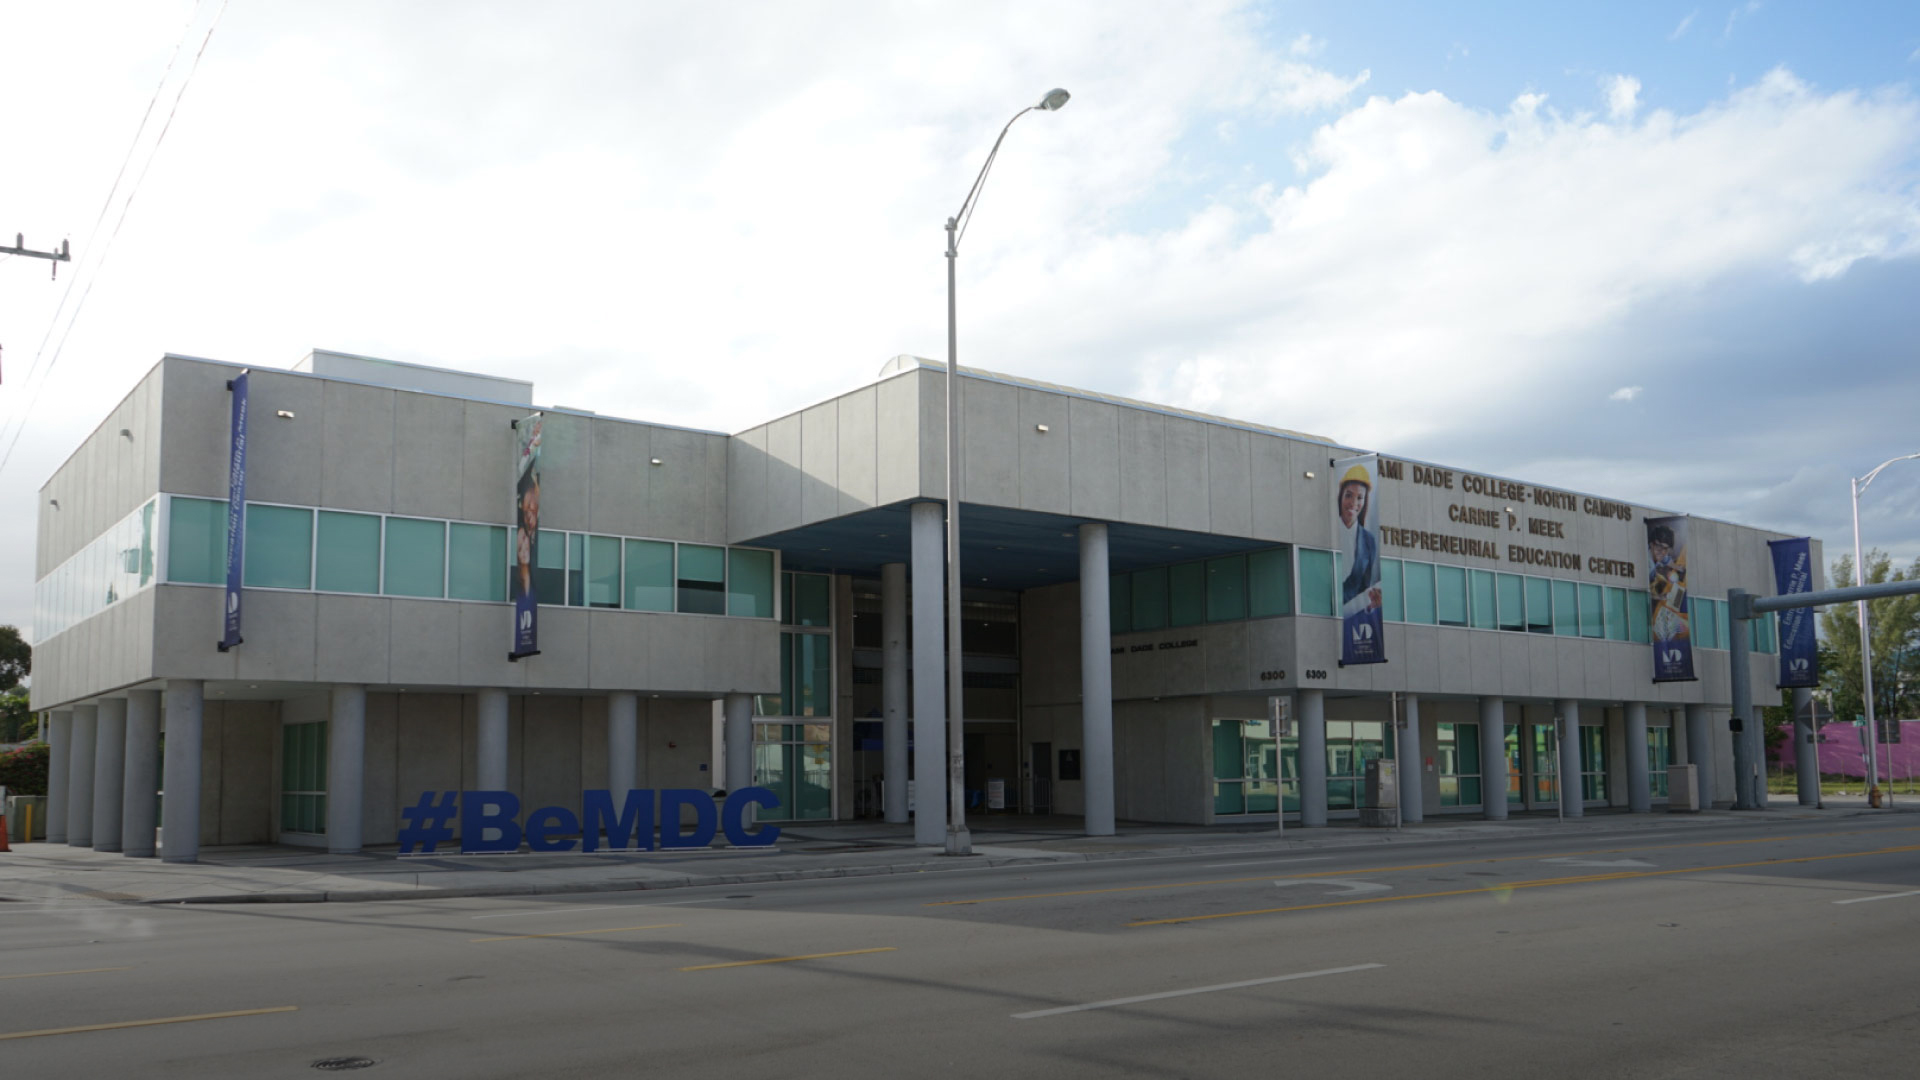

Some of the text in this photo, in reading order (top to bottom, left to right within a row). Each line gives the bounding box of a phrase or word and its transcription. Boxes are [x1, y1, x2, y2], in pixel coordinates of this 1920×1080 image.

[1377, 459, 1403, 480] AMI
[1414, 465, 1453, 489] DADE
[1584, 494, 1632, 521] CAMPUS
[1449, 504, 1564, 539] CARRIE P. MEEK
[1380, 525, 1635, 578] TREPRENEURIAL EDUCATION CENTER
[1261, 670, 1285, 681] 6300
[1306, 669, 1327, 680] 6300
[398, 786, 781, 853] #BeMDC
